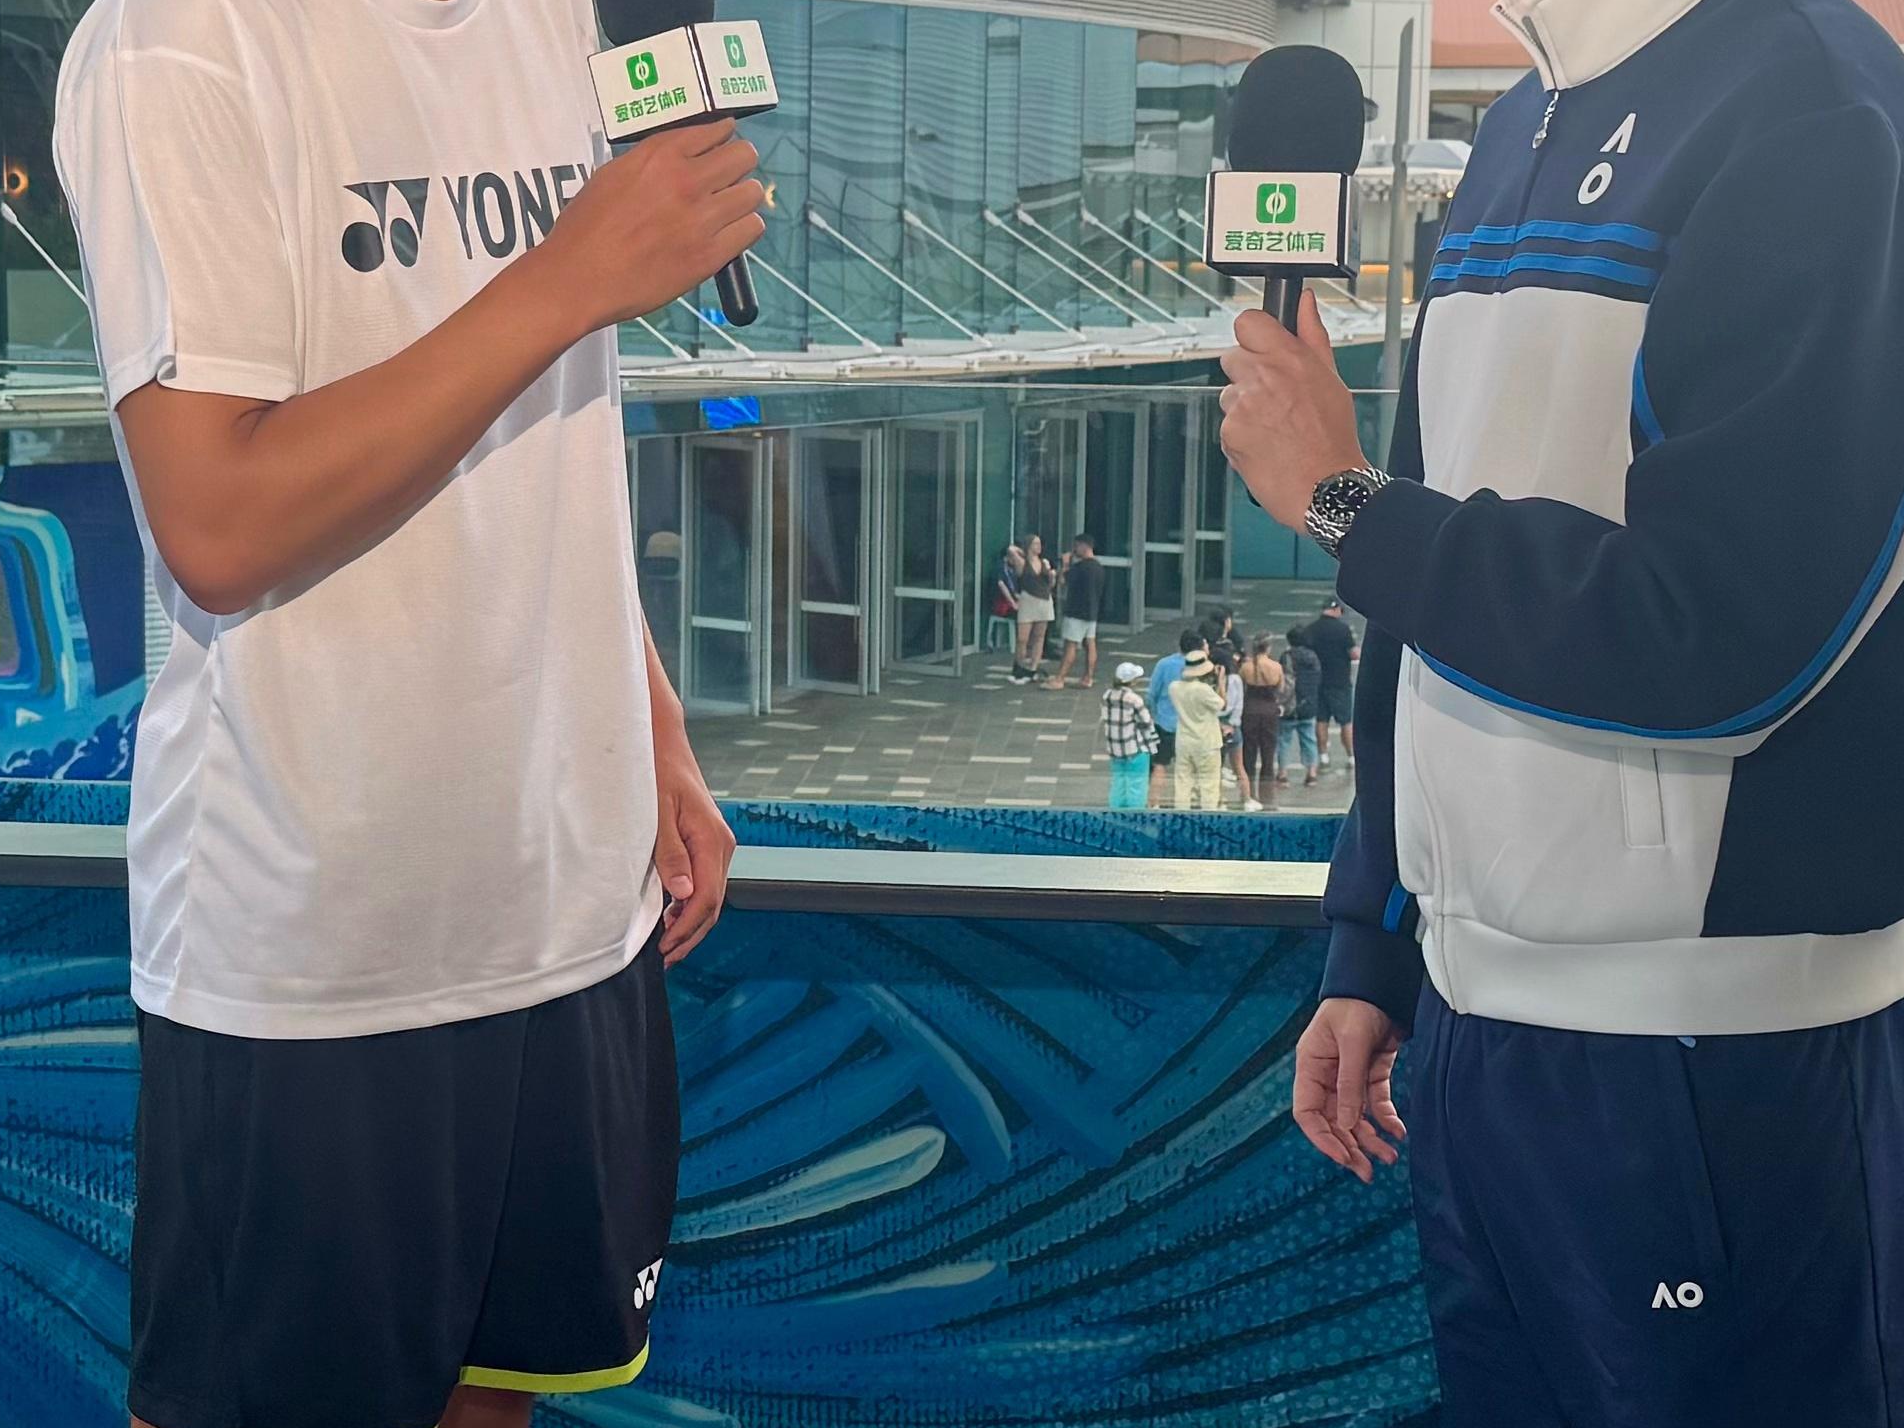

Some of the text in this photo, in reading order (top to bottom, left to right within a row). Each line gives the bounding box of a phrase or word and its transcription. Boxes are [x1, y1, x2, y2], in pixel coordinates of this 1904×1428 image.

[1224, 230, 1326, 253] 爱奇艺体育
